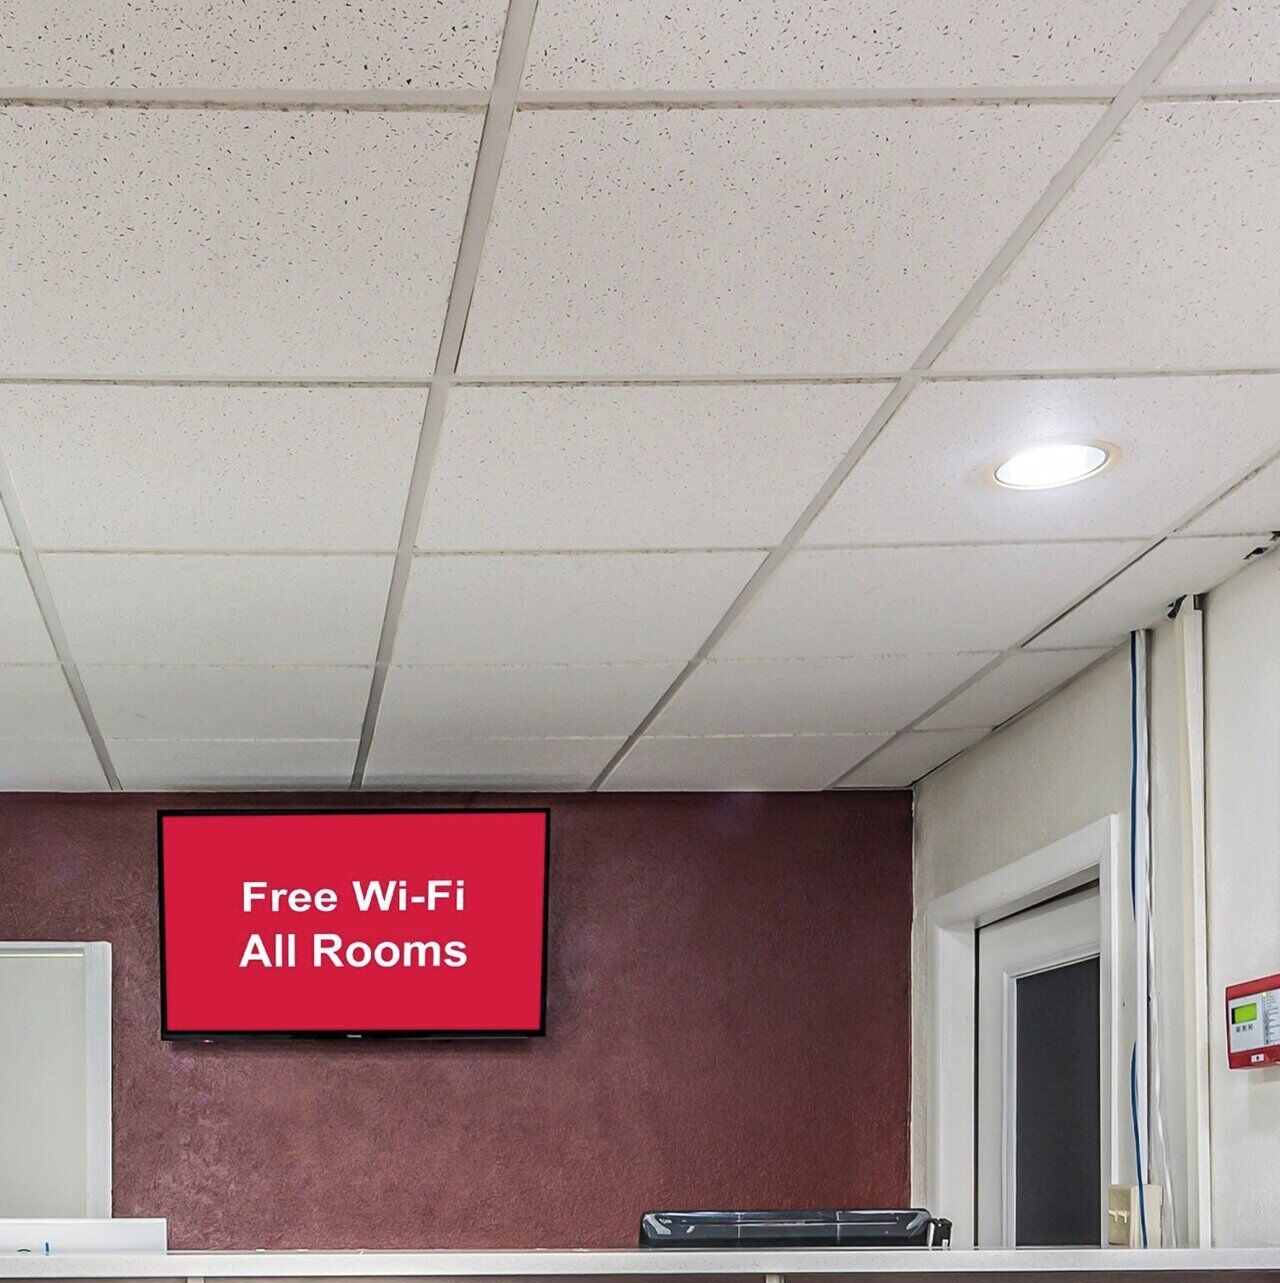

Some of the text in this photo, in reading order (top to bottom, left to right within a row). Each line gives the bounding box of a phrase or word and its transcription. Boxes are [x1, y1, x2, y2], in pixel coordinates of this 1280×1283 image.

[243, 879, 465, 913] Free Wi-Fi
[239, 933, 468, 968] All Rooms
